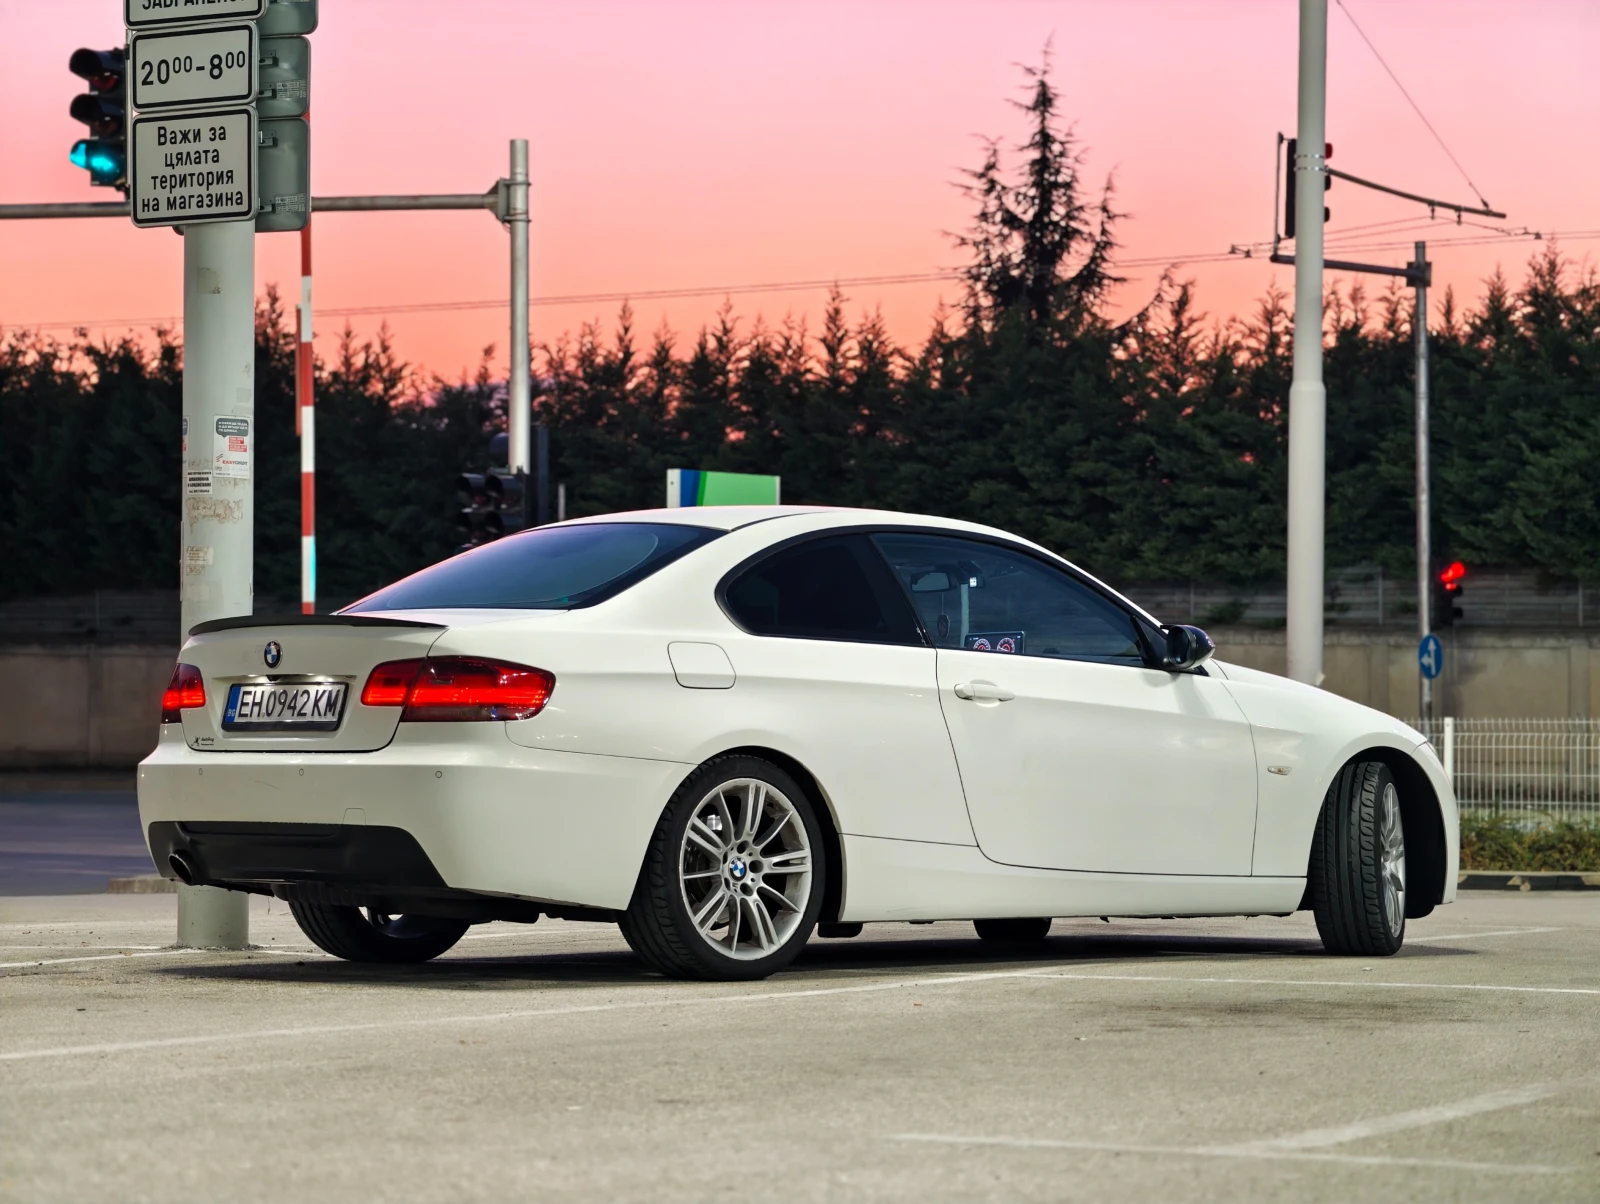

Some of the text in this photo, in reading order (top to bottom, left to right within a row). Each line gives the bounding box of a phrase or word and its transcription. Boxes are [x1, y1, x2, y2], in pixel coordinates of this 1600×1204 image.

[157, 125, 227, 146] Важи за
[164, 148, 220, 170] цялата
[150, 169, 234, 194] територия
[141, 190, 244, 213] на магазина
